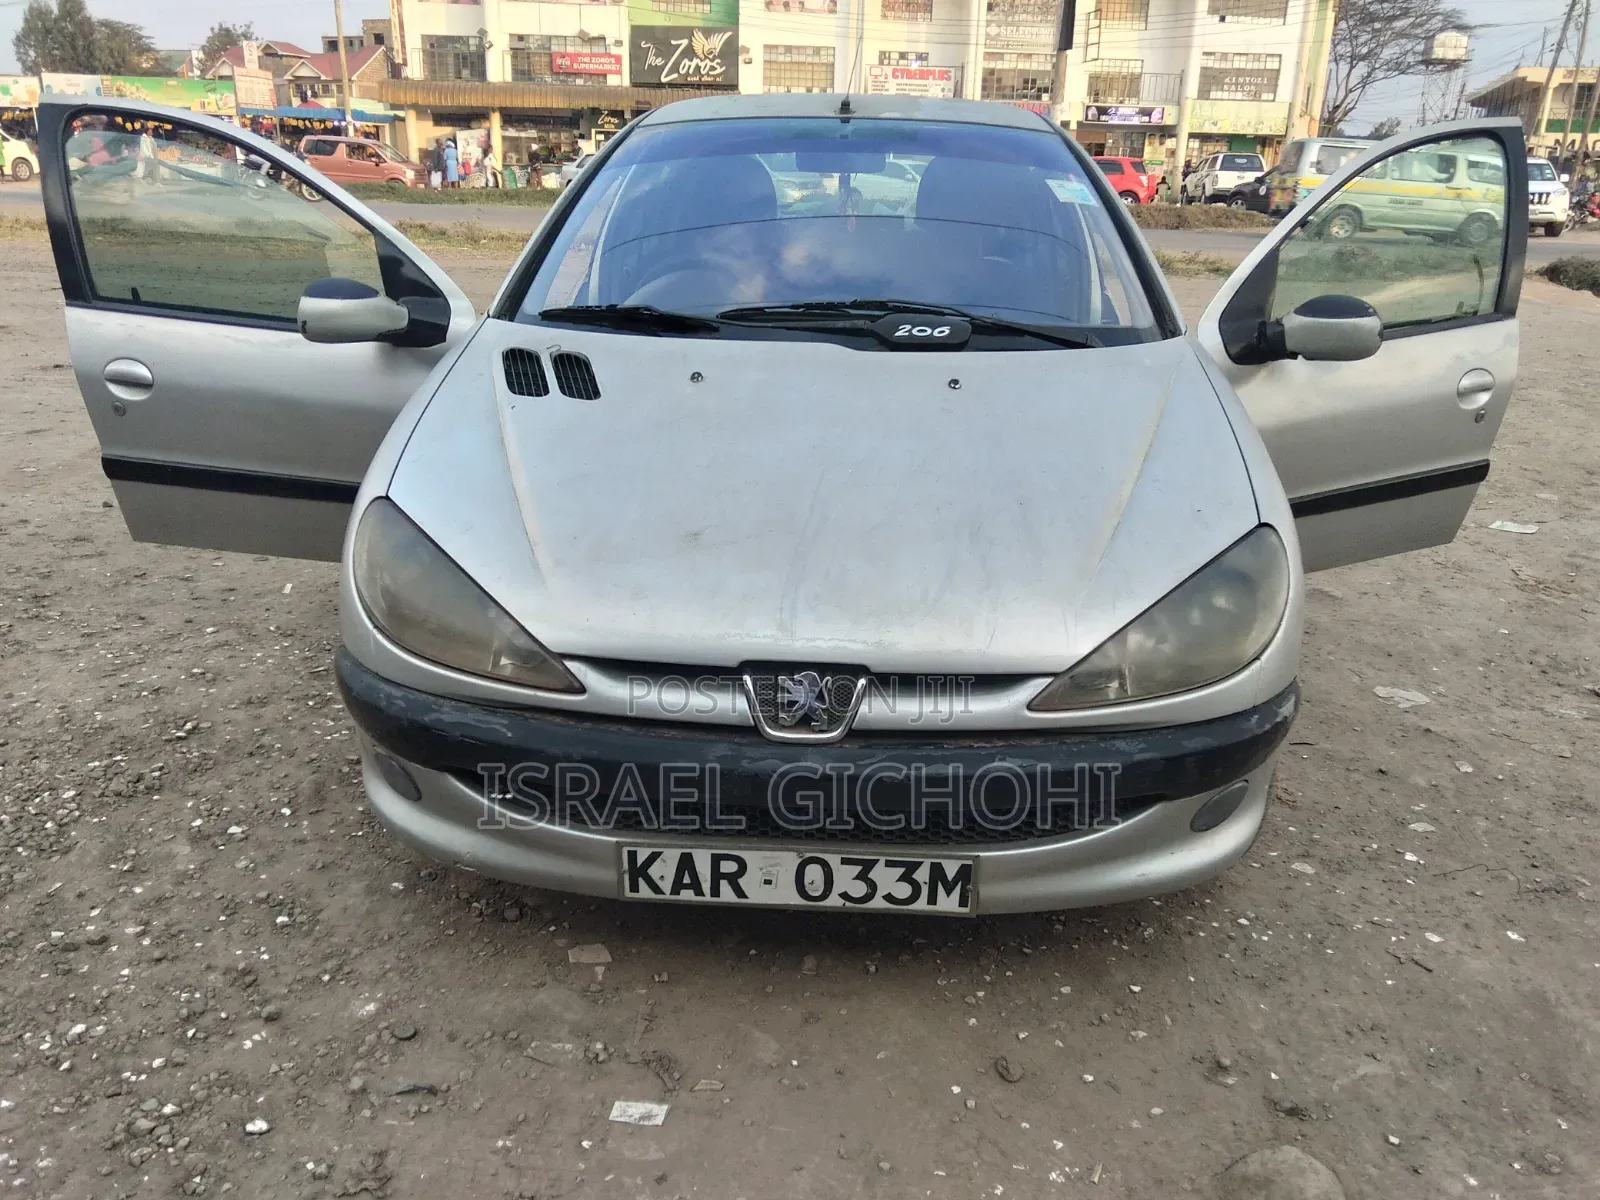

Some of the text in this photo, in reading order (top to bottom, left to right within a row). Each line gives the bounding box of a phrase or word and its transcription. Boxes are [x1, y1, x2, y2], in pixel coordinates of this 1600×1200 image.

[1000, 26, 1037, 39] SELECT
[573, 63, 620, 71] SUPERMARKET
[641, 38, 726, 83] The Zoros
[892, 67, 952, 82] CYBERPLUS
[597, 110, 620, 125] Zoros
[894, 324, 951, 337] 206
[627, 850, 972, 908] KAR 033M
